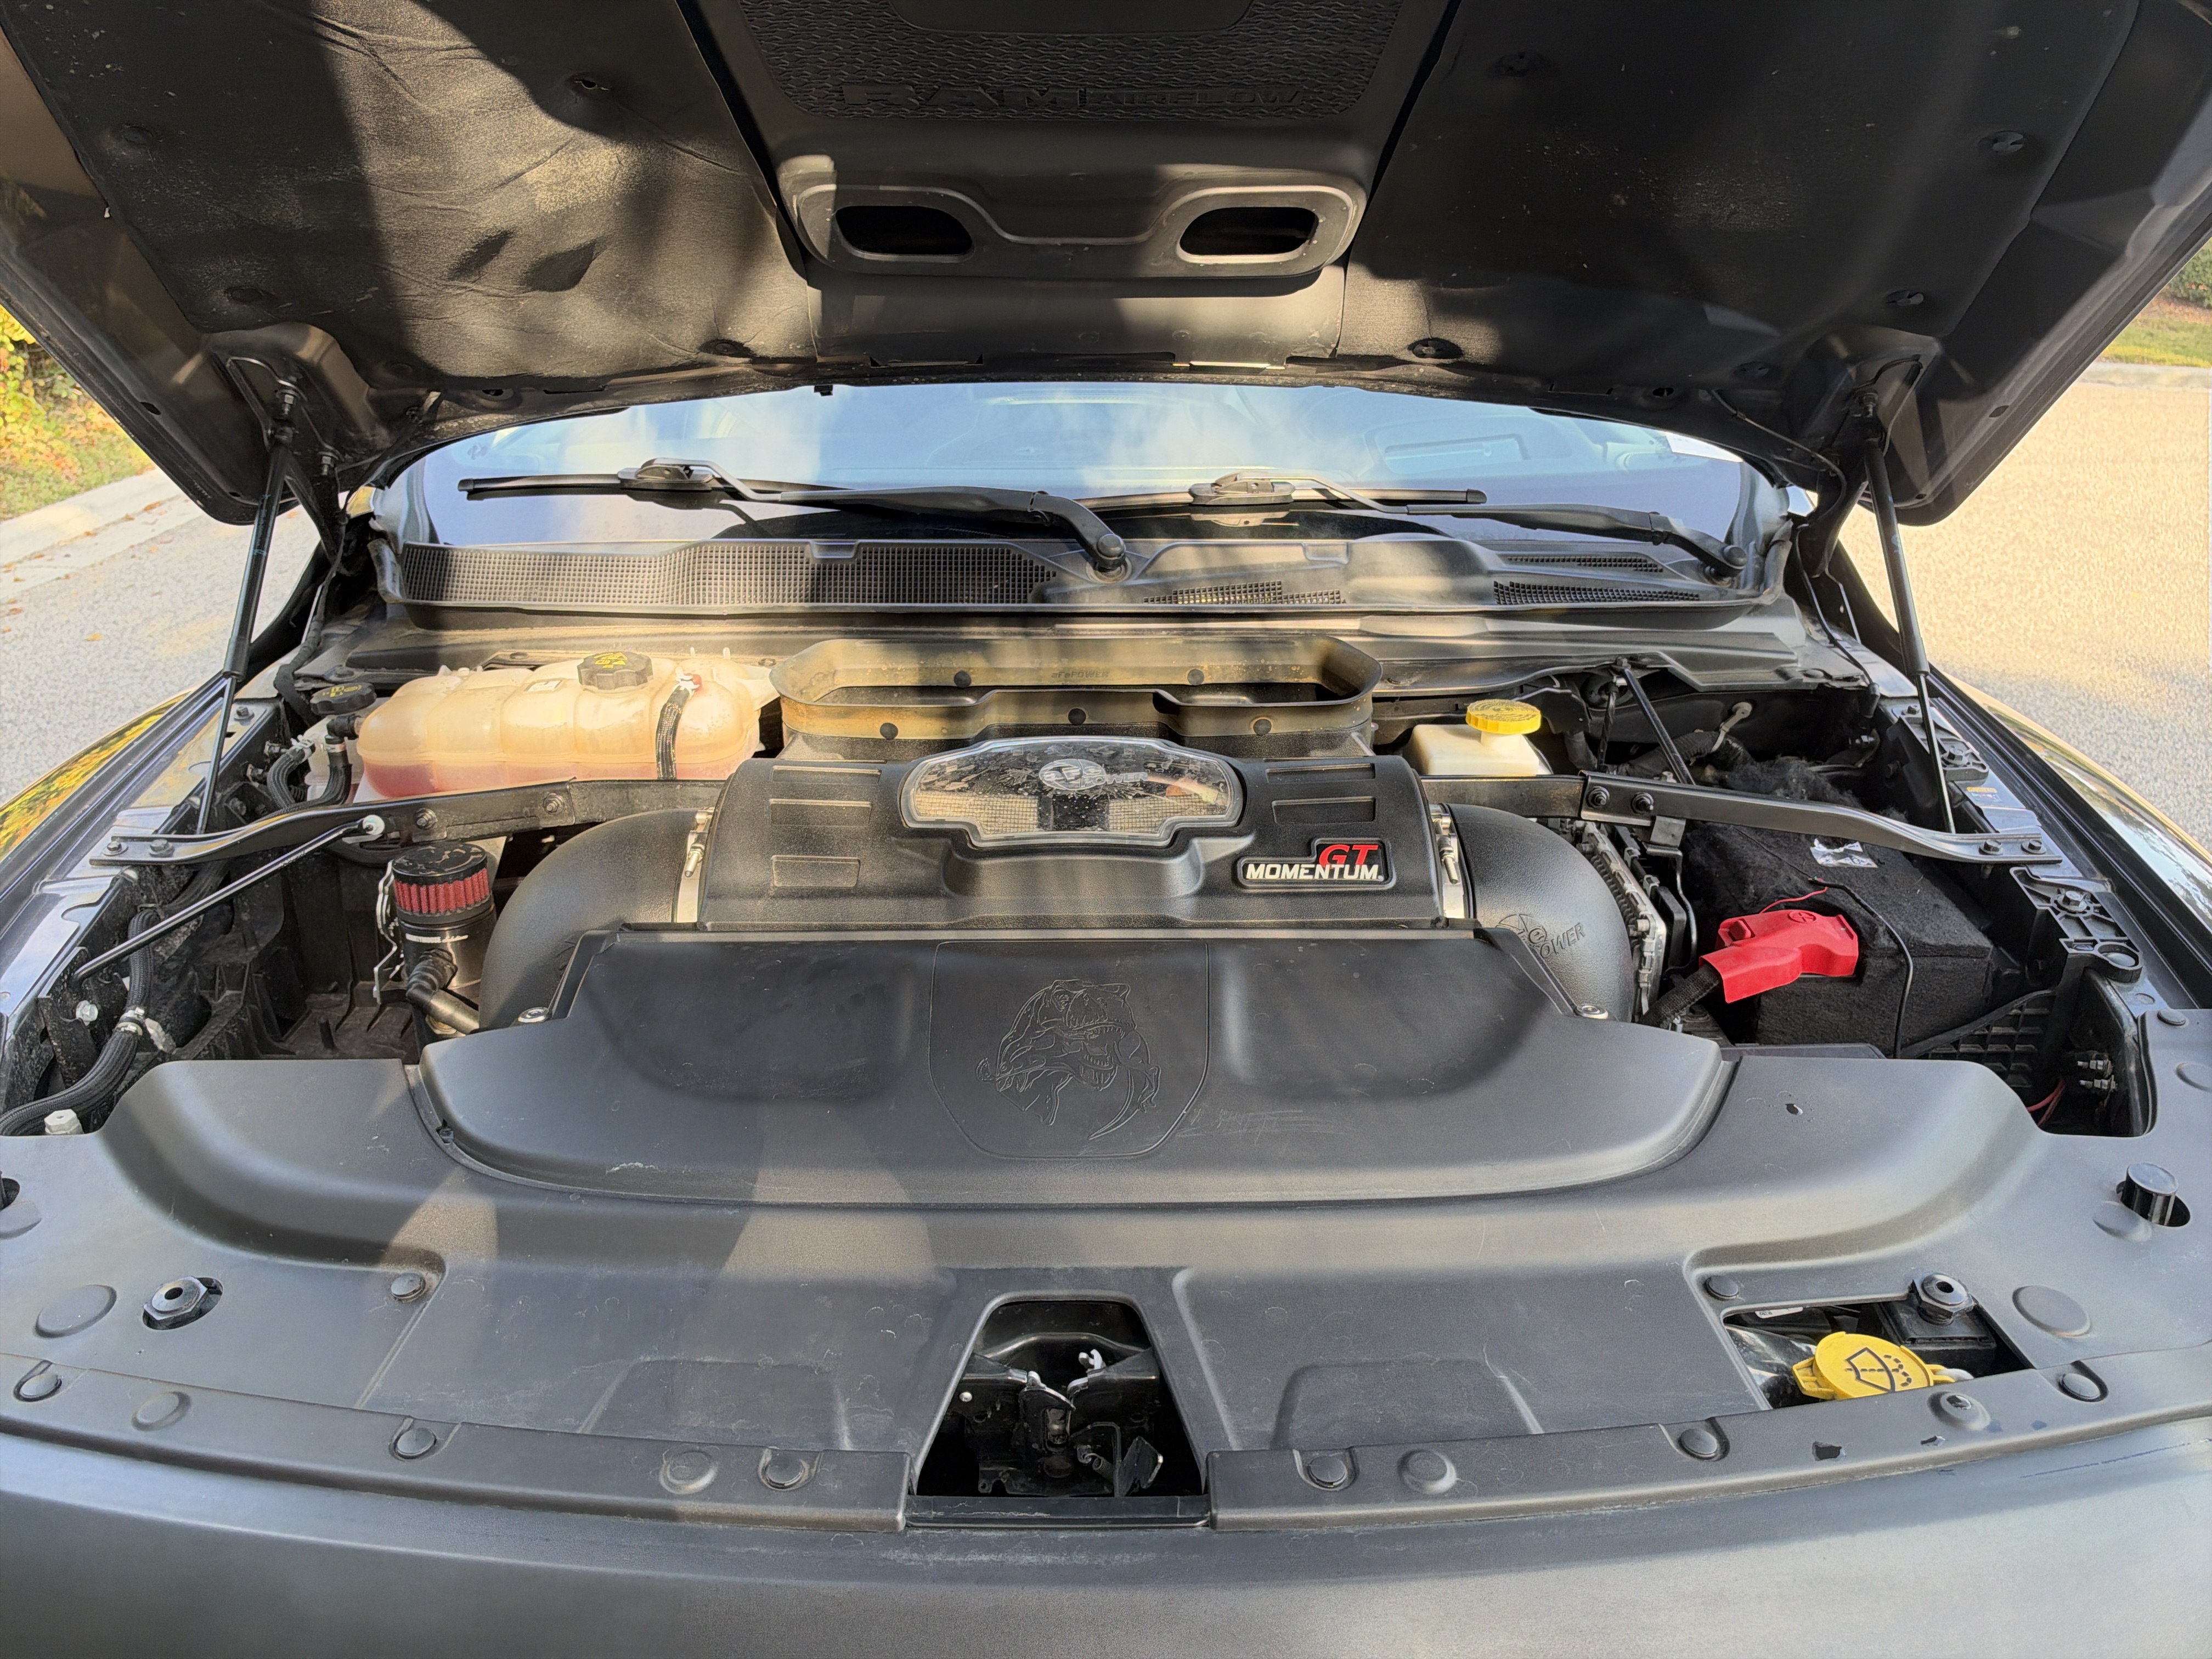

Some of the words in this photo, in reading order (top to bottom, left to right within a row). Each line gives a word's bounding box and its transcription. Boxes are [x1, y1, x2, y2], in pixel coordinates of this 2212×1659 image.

[843, 86, 1079, 109] RAM
[1098, 90, 1302, 105] AIRFLOW
[1081, 772, 1148, 788] POWER
[1319, 844, 1378, 868] GT
[1536, 922, 1586, 958] OWER
